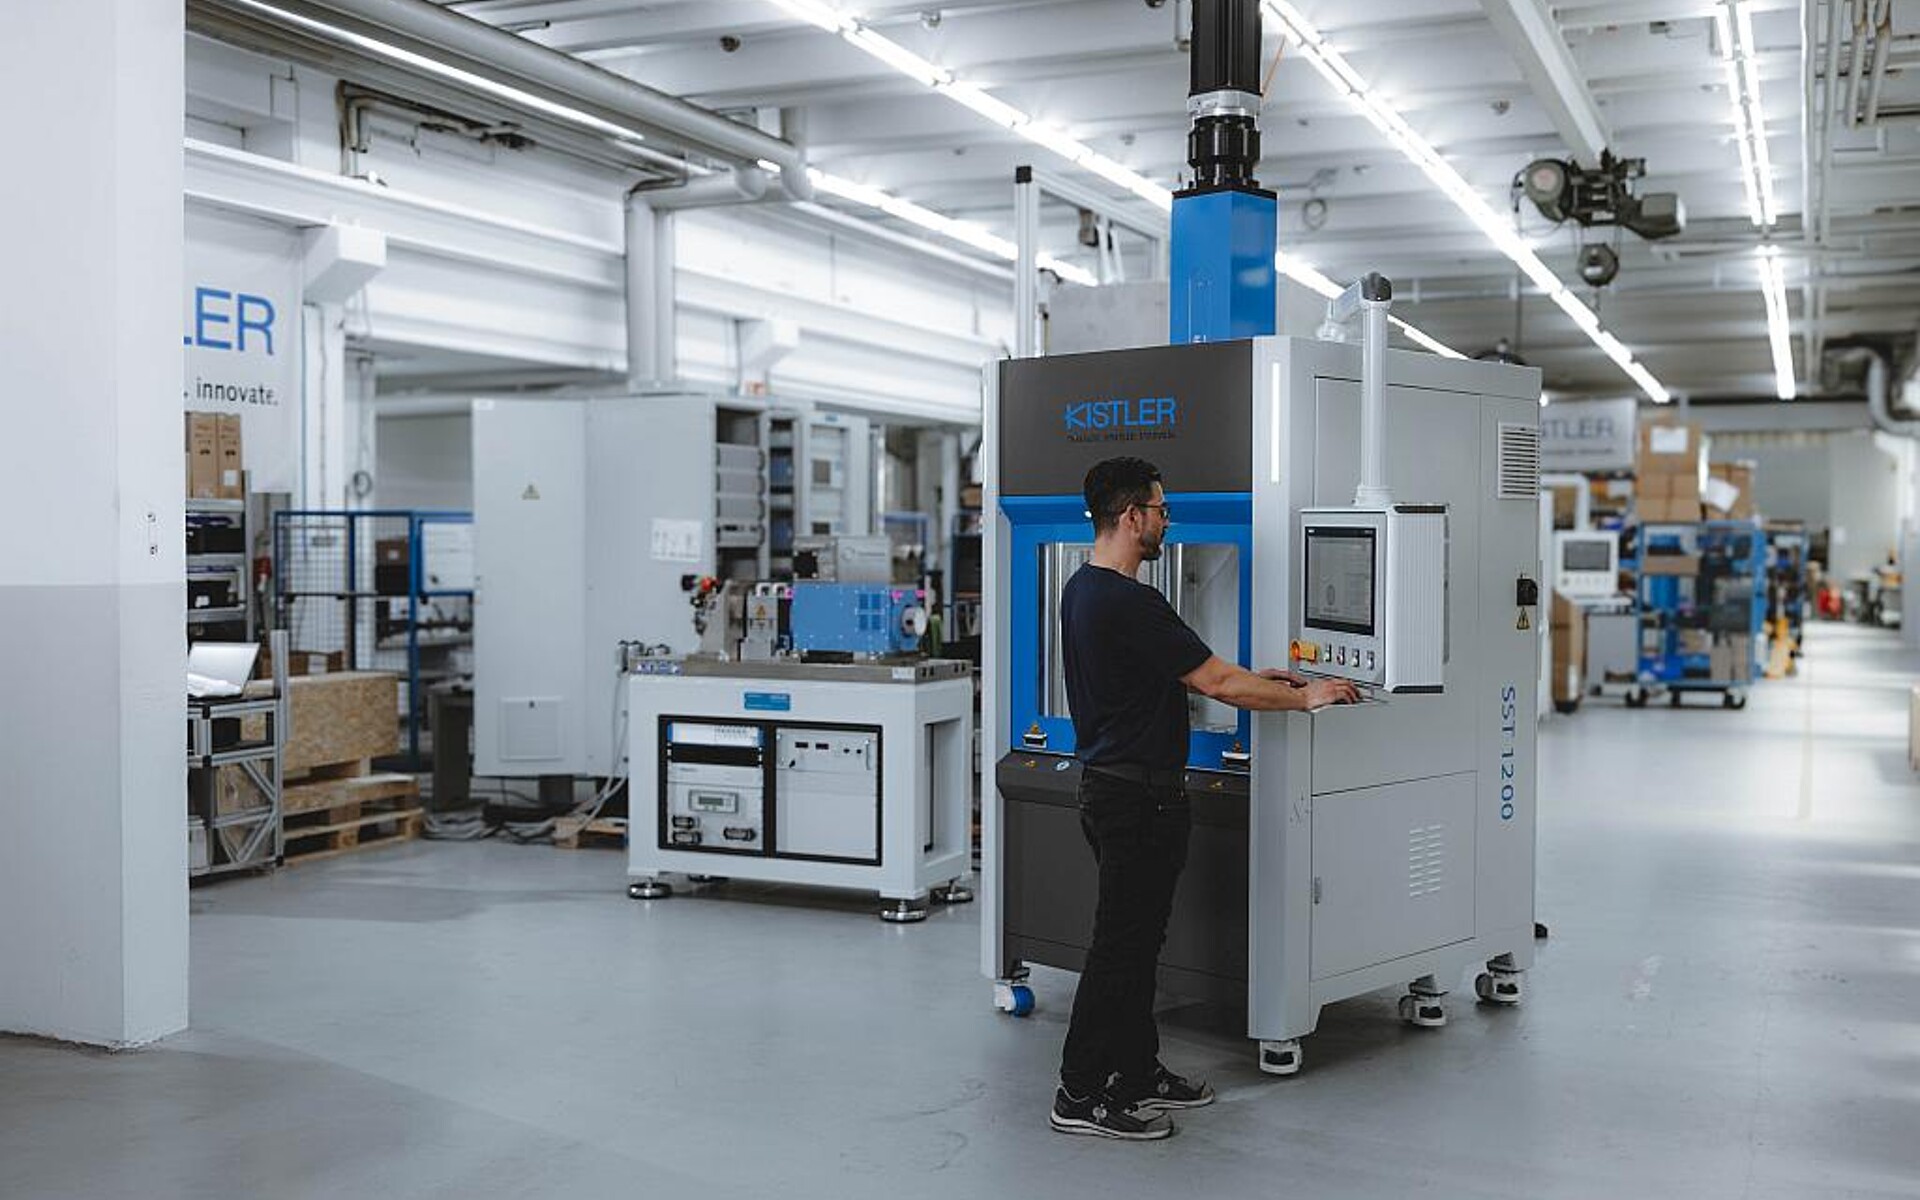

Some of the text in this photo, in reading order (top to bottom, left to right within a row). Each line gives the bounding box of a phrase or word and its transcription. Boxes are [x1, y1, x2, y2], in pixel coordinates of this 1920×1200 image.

[196, 377, 279, 405] innovate.
[1064, 397, 1177, 430] KISTLER
[1501, 686, 1516, 820] SST 1200
